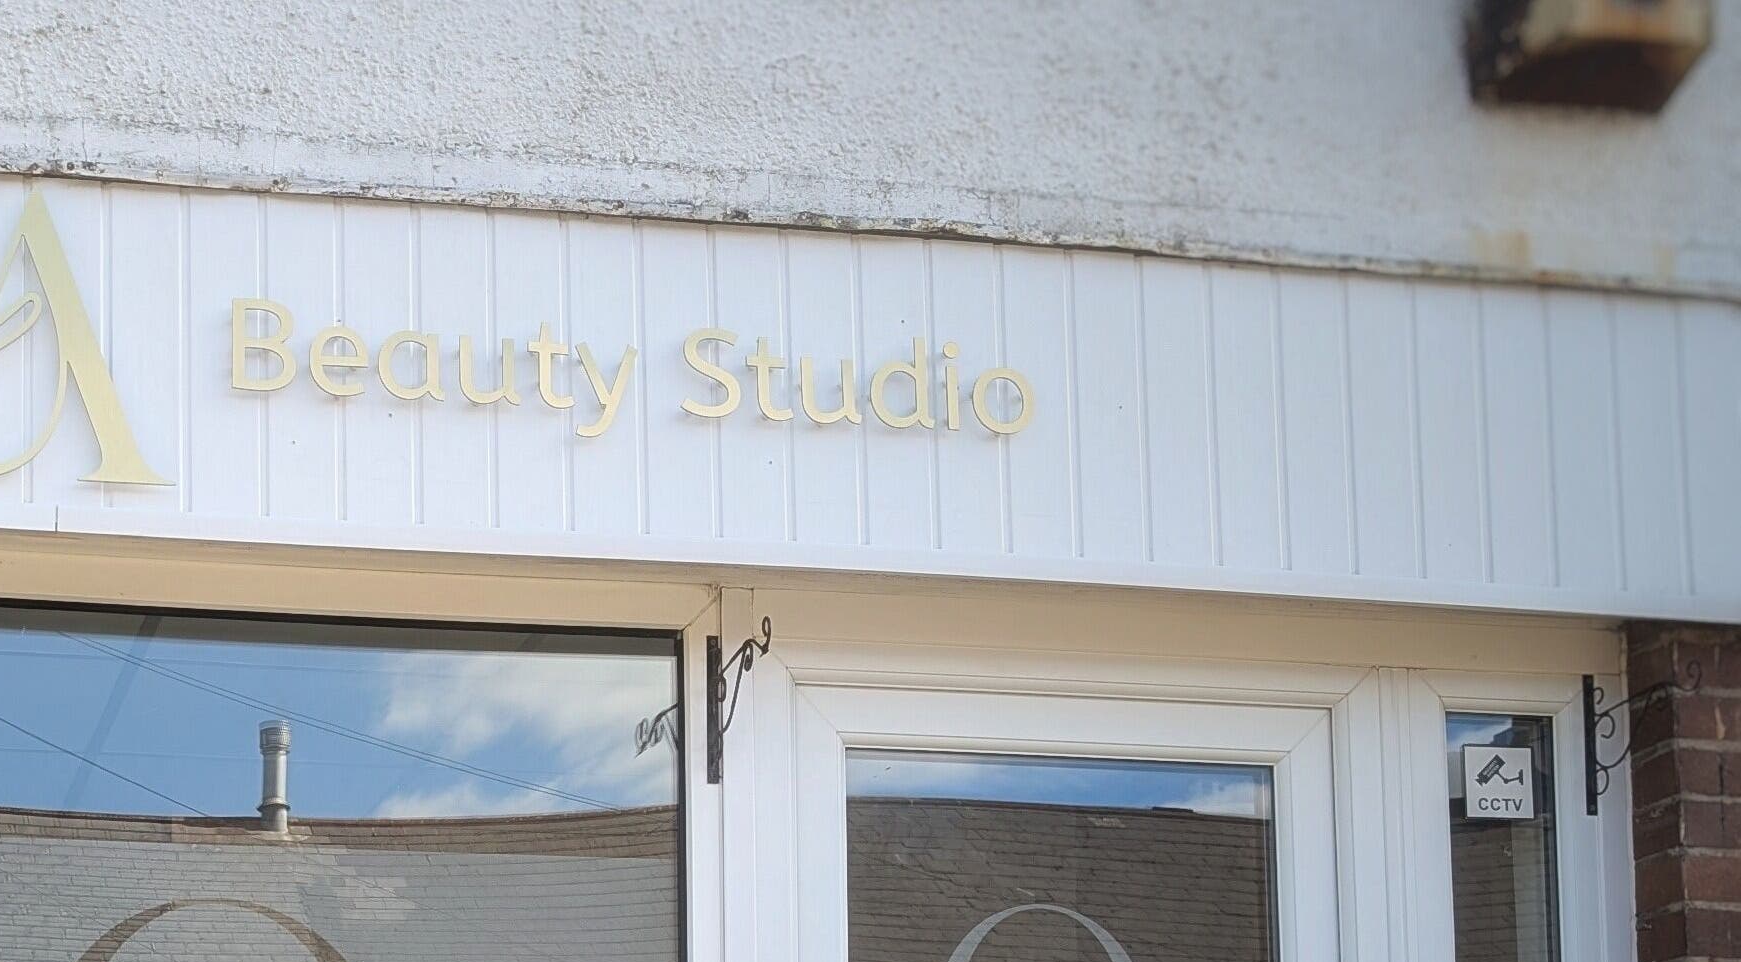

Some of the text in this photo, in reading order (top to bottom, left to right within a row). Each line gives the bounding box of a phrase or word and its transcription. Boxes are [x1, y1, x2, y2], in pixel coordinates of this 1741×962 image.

[229, 297, 639, 438] Beauty
[680, 326, 1036, 436] Studio
[1478, 798, 1523, 811] CCTV
